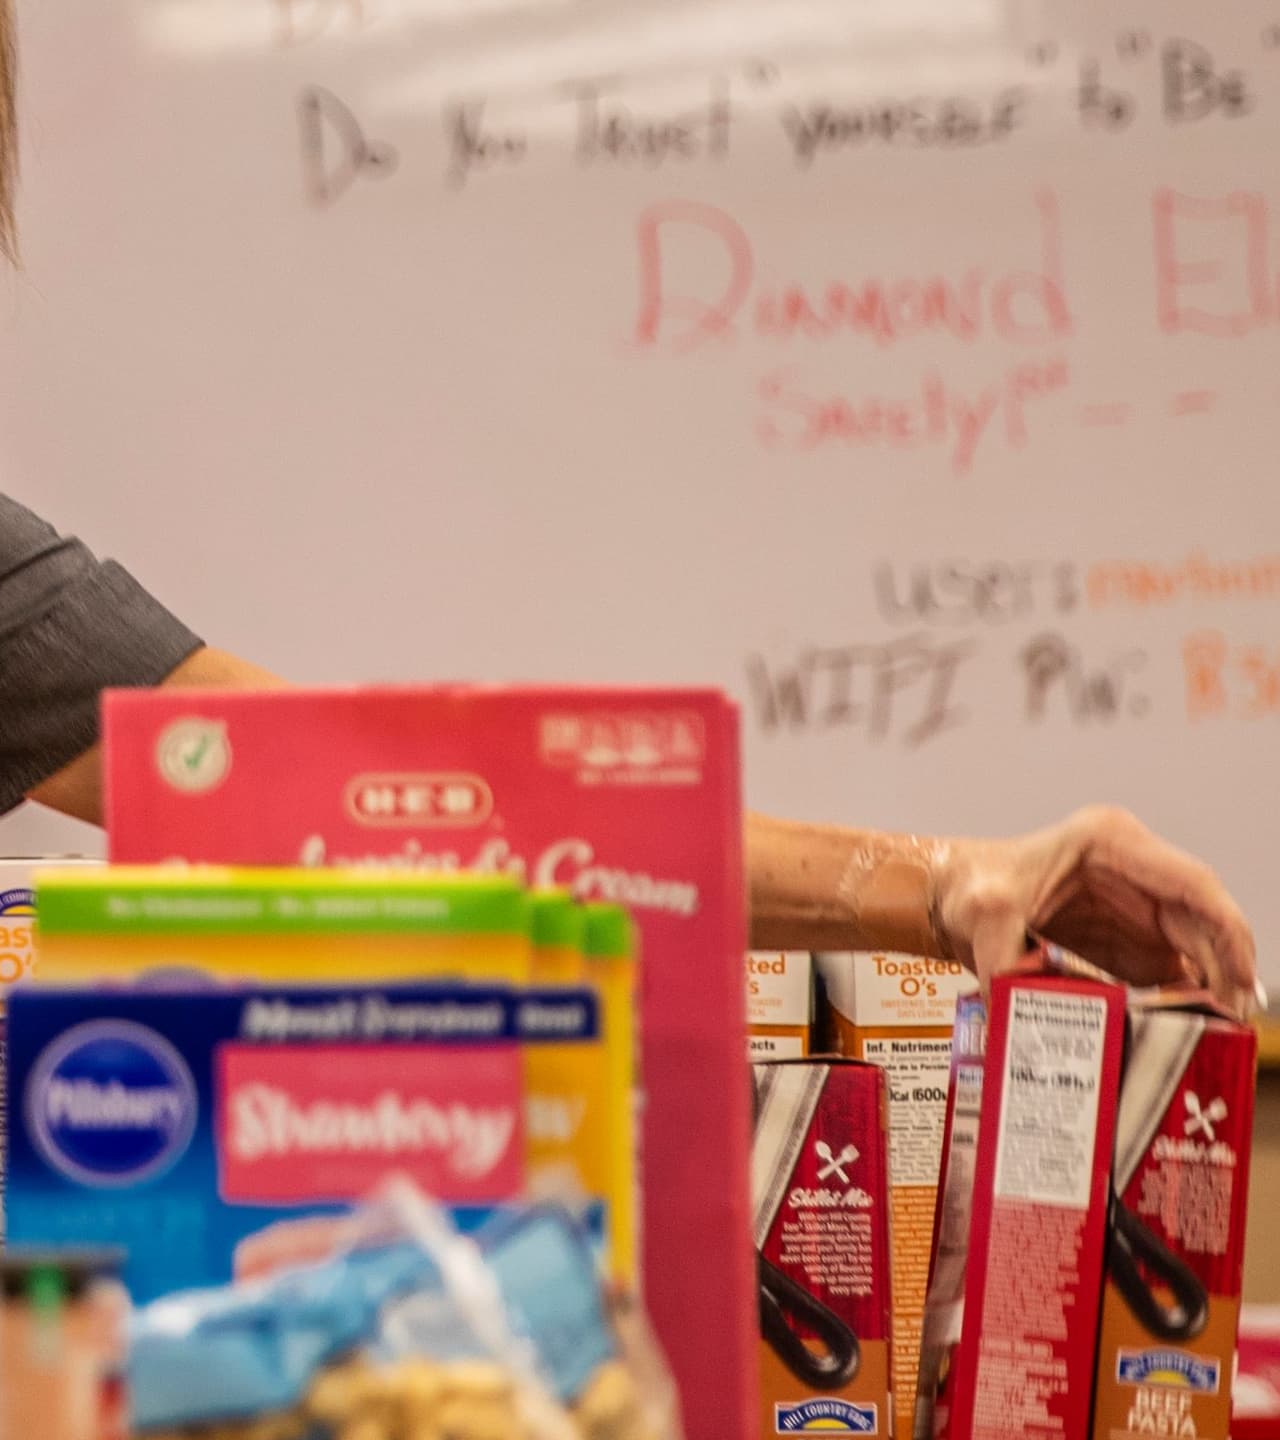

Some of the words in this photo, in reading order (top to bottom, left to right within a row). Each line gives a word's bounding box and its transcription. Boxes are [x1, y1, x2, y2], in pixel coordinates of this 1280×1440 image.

[872, 952, 962, 976] Toasted
[900, 977, 937, 997] O's
[783, 1410, 804, 1430] HILL
[804, 1401, 848, 1418] COUNTRY
[1136, 1386, 1192, 1417] BEEF
[1128, 1407, 1196, 1440] PASTA
